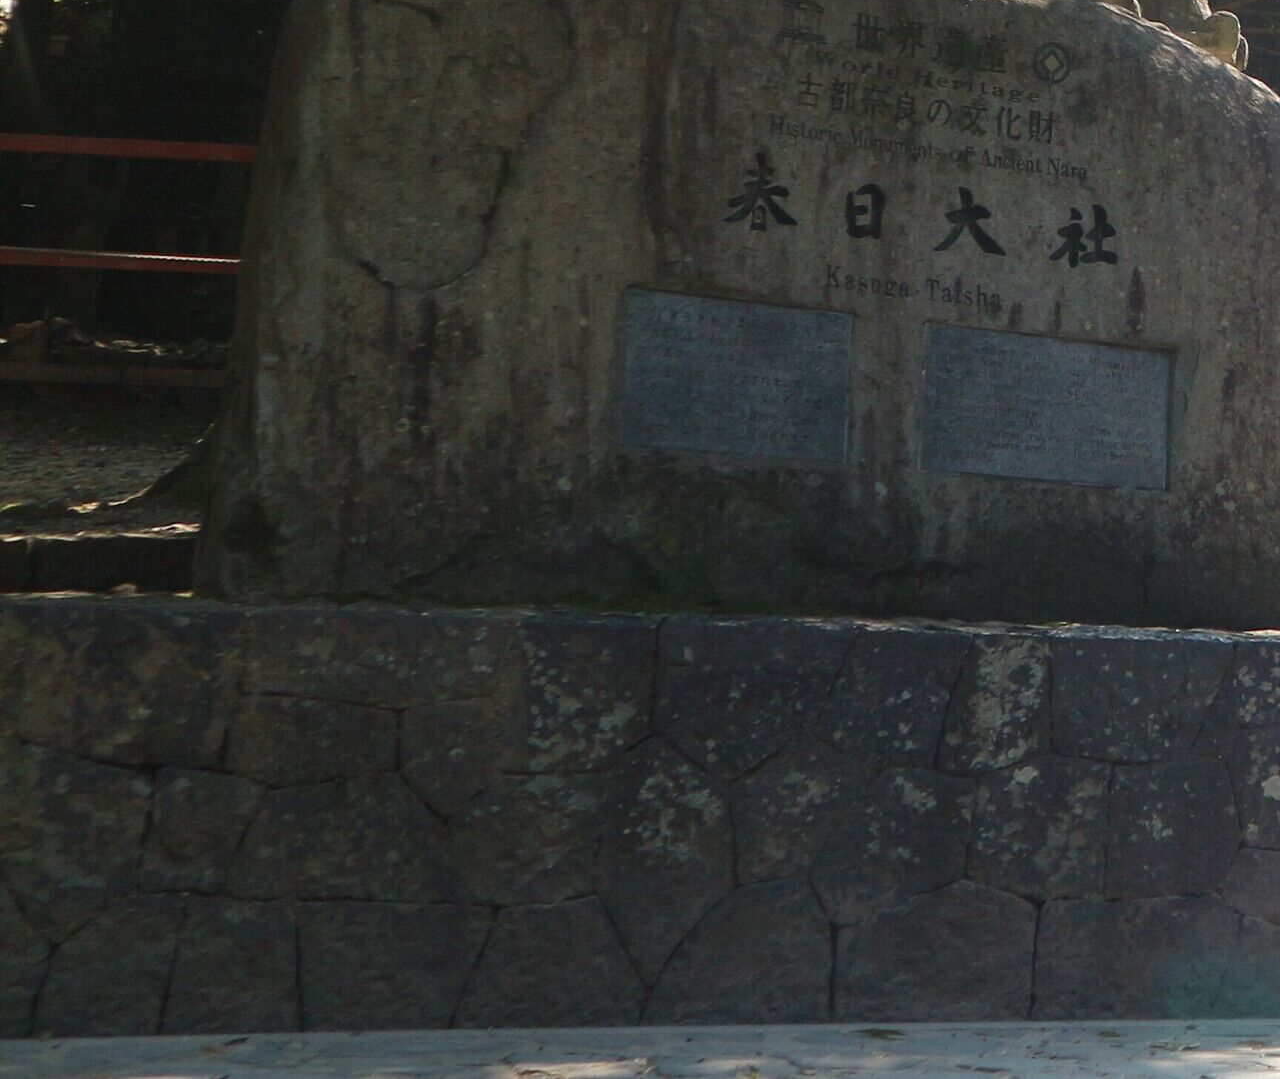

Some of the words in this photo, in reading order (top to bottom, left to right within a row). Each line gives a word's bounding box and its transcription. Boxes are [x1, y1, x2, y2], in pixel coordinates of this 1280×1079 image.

[815, 50, 901, 81] World
[915, 68, 1041, 103] Heritage
[855, 13, 1008, 74] 世界遺産
[796, 73, 1056, 144] 古都奈良の文化財
[770, 114, 842, 146] Historic
[950, 145, 976, 164] of
[981, 148, 1042, 174] Ancient
[1047, 157, 1088, 182] Nara
[724, 152, 1119, 268] 春日大社
